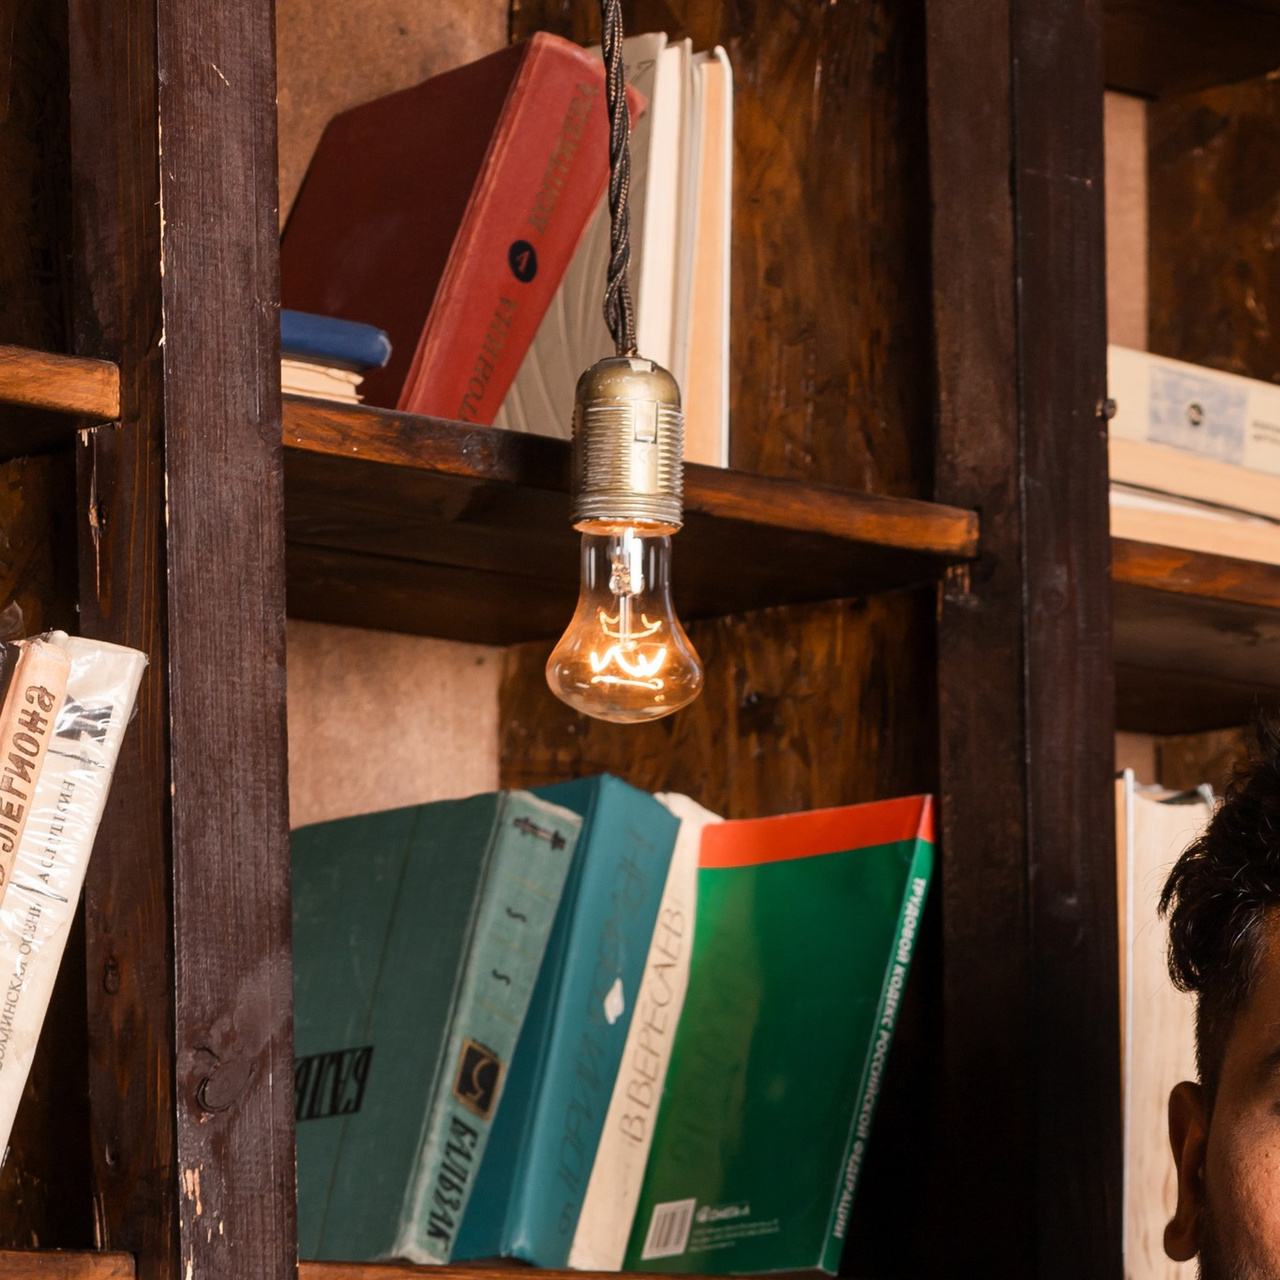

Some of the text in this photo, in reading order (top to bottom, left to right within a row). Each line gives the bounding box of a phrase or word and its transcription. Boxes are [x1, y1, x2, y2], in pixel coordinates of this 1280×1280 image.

[626, 907, 686, 1109] ВЕРЕСАЕВ
[832, 877, 926, 1239] ТРУДОВОЙ КОДЕКС РОССИЙСКОЙ ФЕДЕРАЦИИ
[427, 1116, 478, 1252] БАЛЬЗАК
